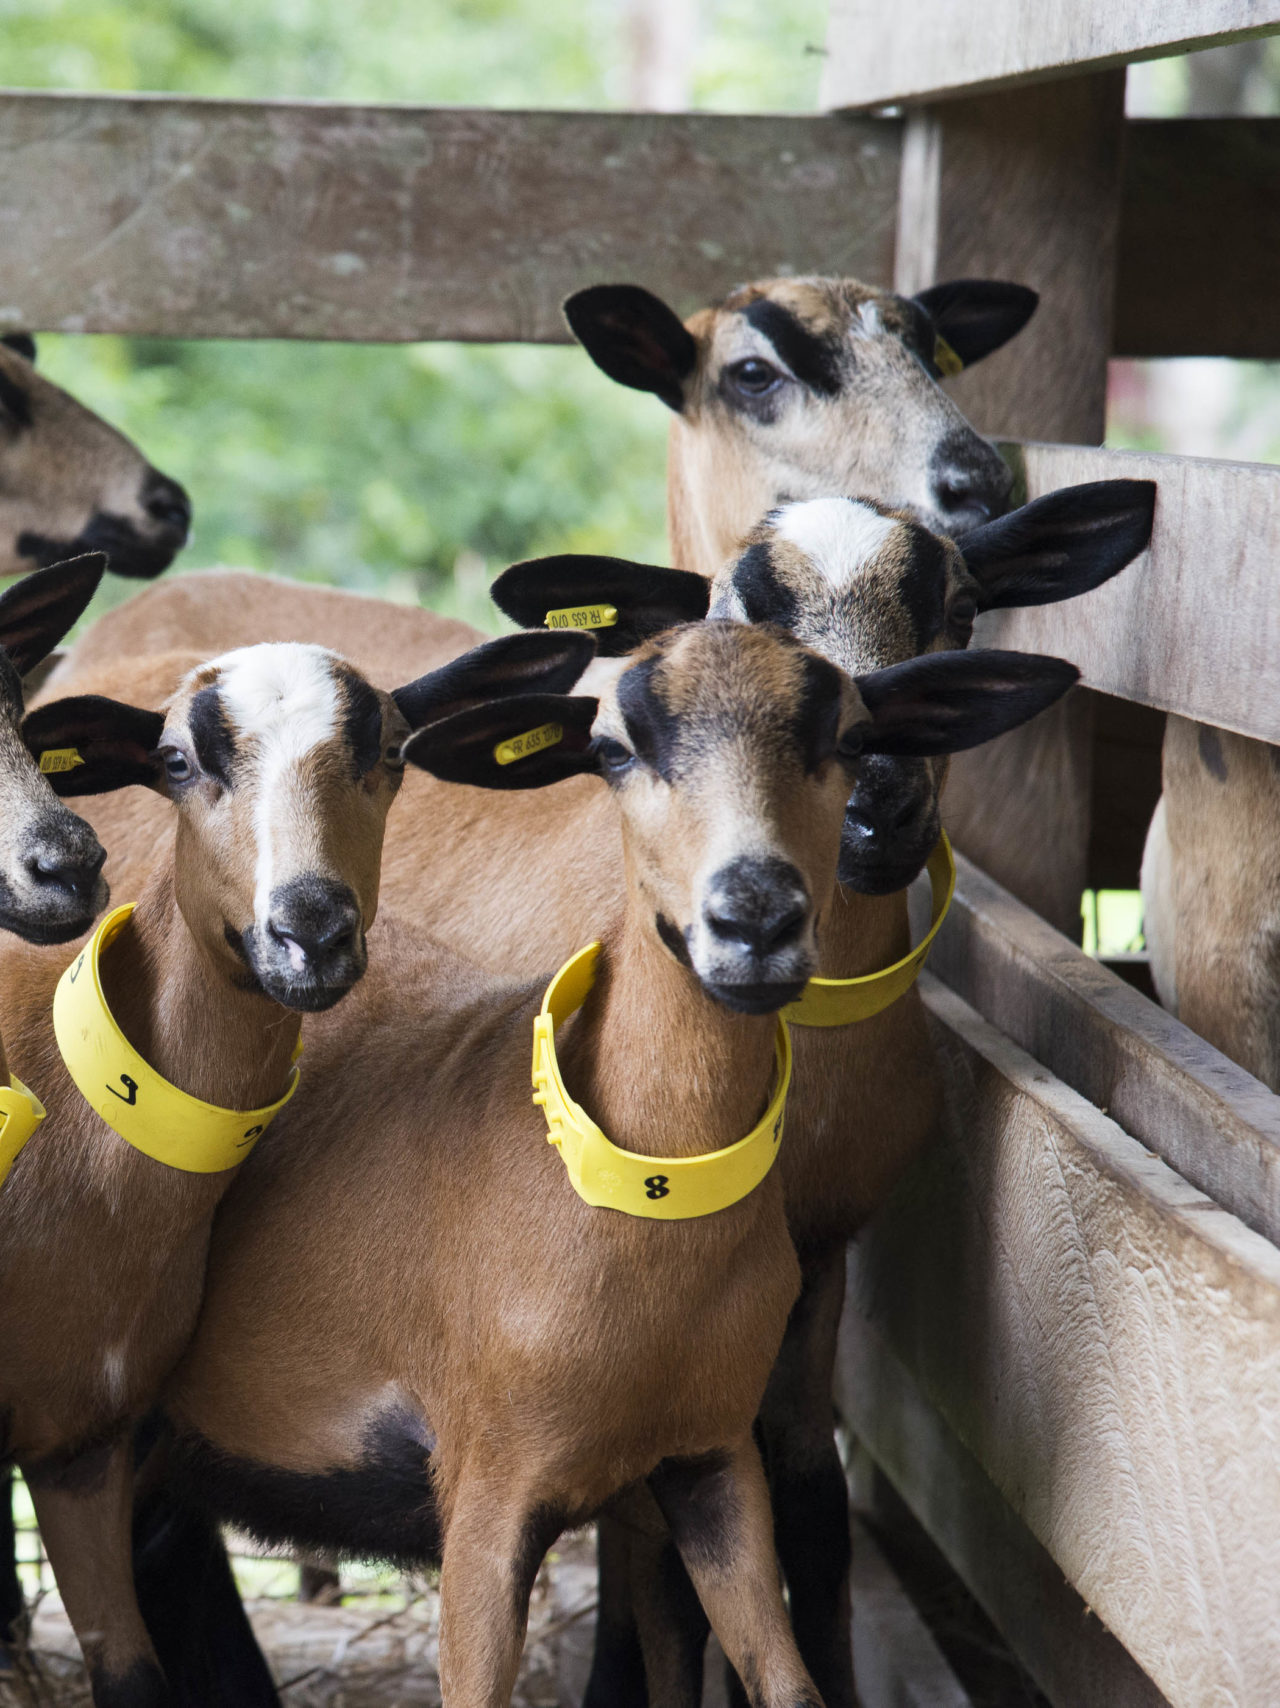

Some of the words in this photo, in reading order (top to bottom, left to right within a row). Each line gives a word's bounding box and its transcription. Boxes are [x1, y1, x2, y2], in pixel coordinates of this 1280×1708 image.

[551, 613, 569, 629] 070
[571, 611, 588, 627] 635
[590, 609, 602, 625] FR
[643, 1174, 670, 1200] 8
